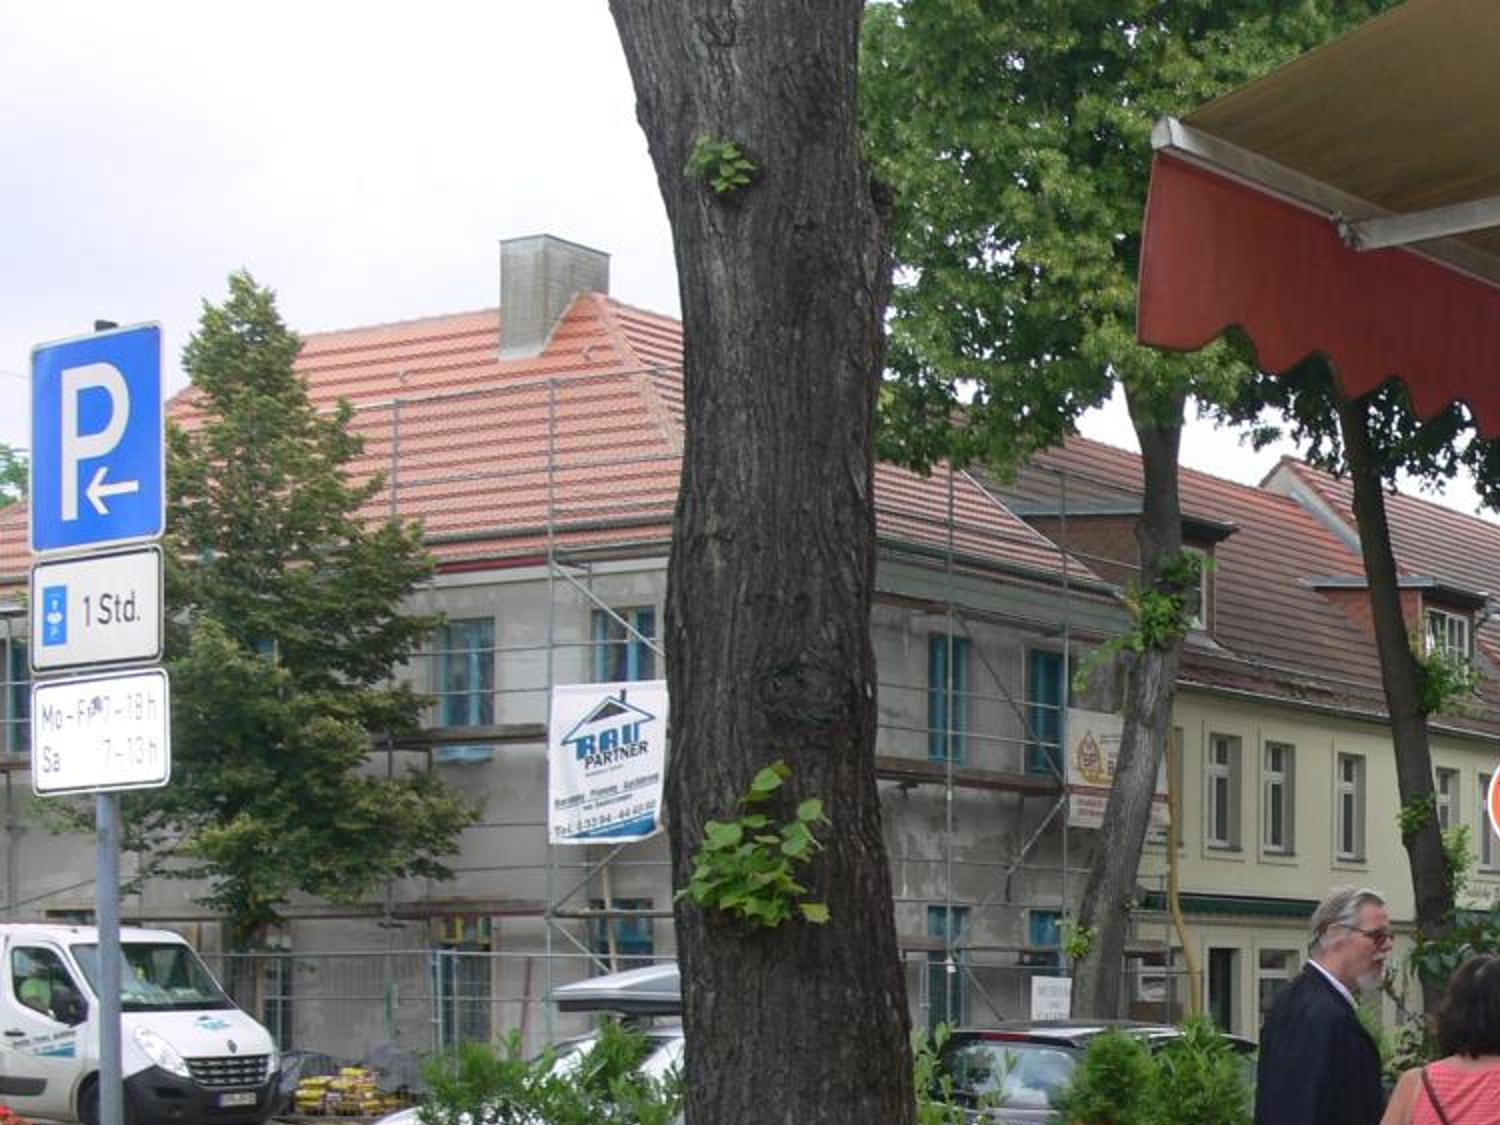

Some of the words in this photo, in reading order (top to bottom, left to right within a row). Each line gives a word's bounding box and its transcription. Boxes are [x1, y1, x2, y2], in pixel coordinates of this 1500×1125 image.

[61, 362, 130, 521] P
[84, 595, 91, 627] 1
[98, 590, 141, 624] Std.
[43, 745, 61, 773] Sa
[585, 740, 649, 770] PARTNER
